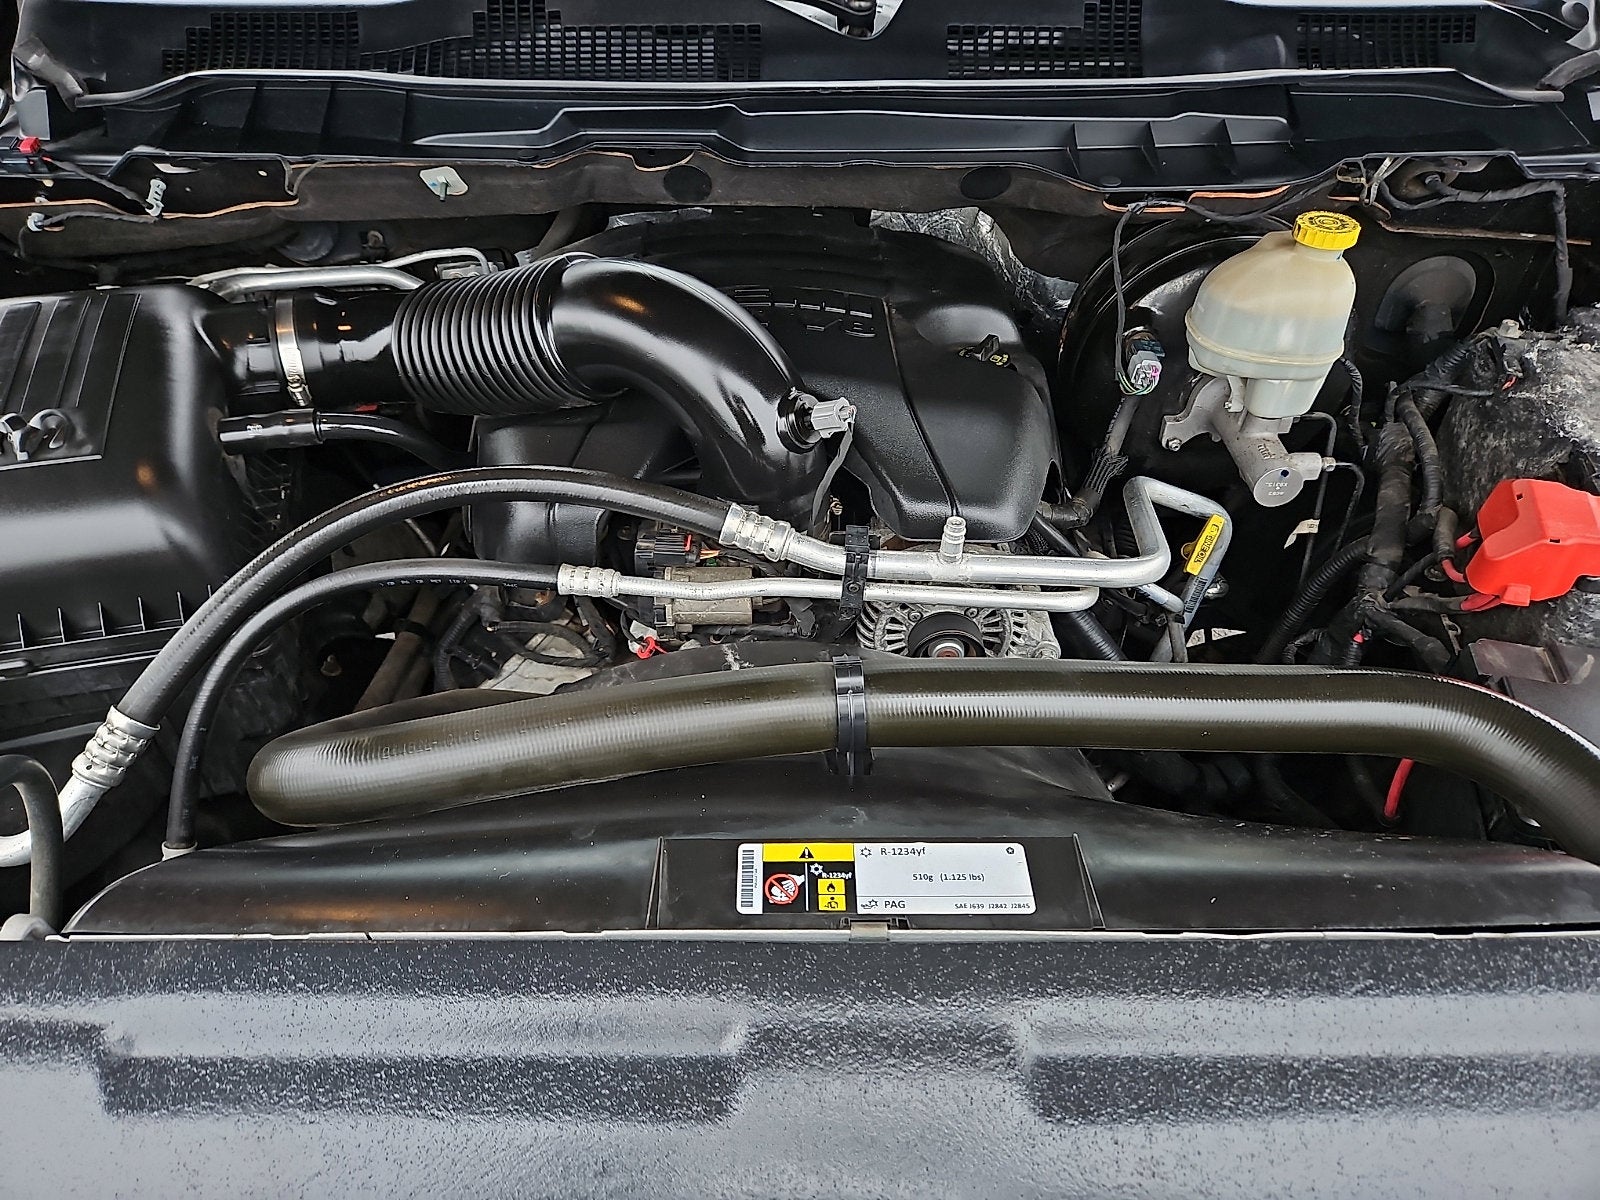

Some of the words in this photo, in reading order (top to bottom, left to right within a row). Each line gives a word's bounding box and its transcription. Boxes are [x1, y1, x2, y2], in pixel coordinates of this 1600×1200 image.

[881, 846, 926, 857] R-1234yf
[821, 871, 852, 880] R-1234yf
[912, 873, 933, 883] 510g
[940, 873, 967, 882] (1.125
[969, 873, 985, 882] lbs)
[884, 900, 906, 909] PAG
